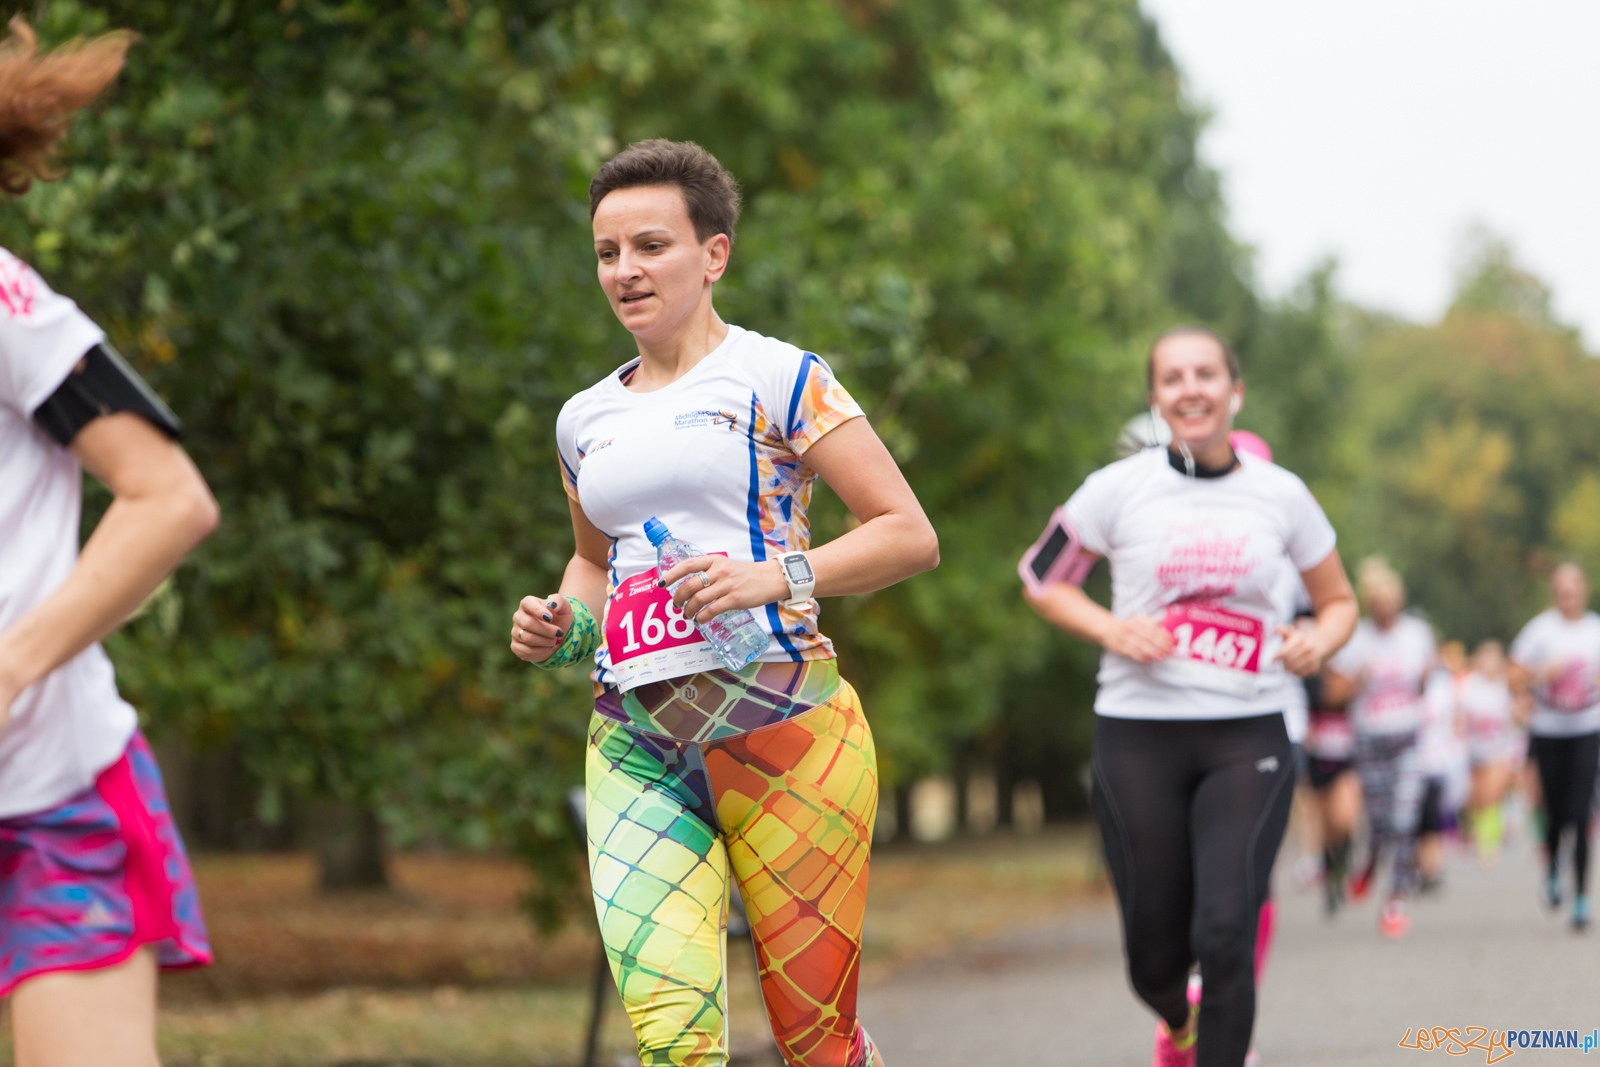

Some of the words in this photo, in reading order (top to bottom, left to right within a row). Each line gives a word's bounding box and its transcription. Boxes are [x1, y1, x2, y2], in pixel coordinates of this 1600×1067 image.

[675, 410, 705, 420] Midnight
[675, 418, 708, 426] Marathon
[1173, 622, 1257, 669] 1467
